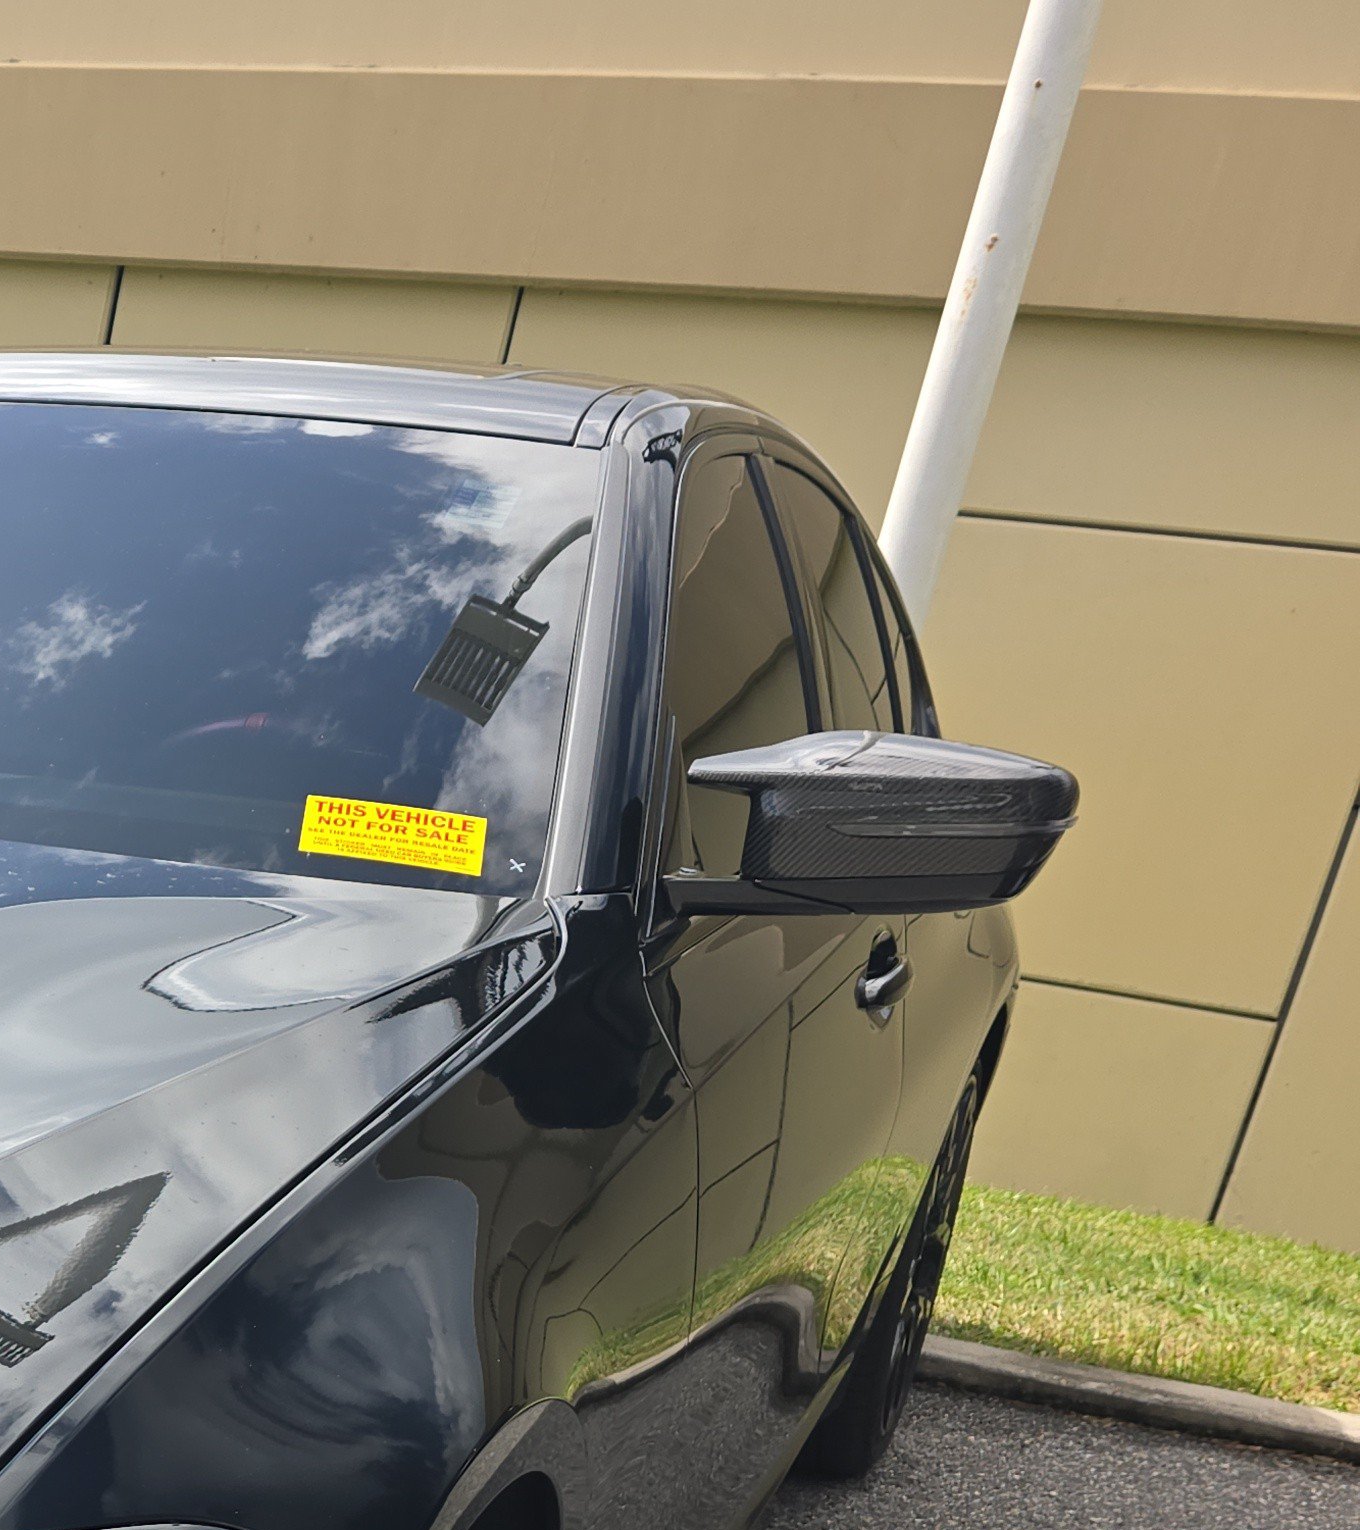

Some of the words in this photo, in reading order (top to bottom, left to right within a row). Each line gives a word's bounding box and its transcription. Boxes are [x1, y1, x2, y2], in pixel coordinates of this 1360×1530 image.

[315, 800, 367, 817] THIS
[375, 807, 476, 833] VEHICLE
[318, 816, 360, 828] NOT
[366, 821, 408, 835] FOR
[415, 827, 469, 845] SALE
[349, 832, 387, 841] DEALER
[412, 840, 449, 851] RESALE
[451, 846, 476, 855] DATE
